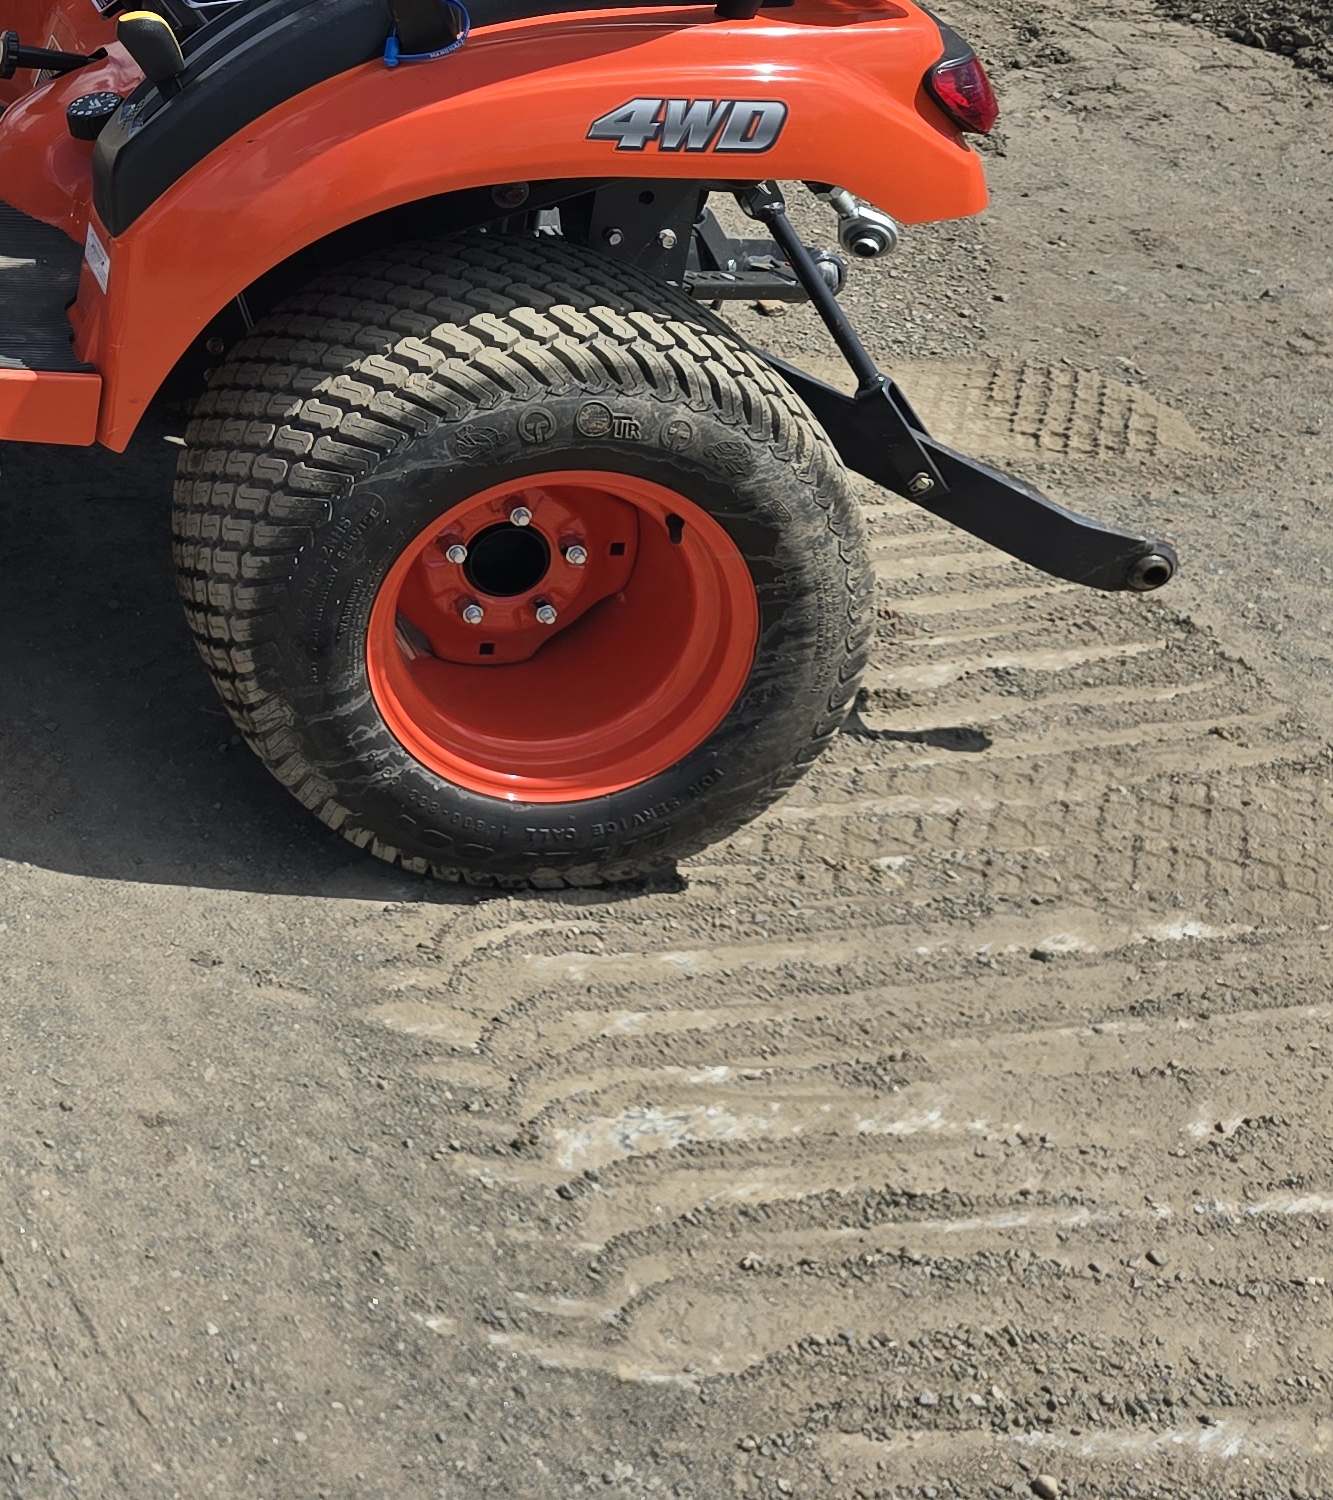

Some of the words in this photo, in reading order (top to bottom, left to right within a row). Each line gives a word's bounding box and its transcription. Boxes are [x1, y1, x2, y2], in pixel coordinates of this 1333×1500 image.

[585, 97, 788, 153] 4WD
[524, 825, 578, 841] CALL
[591, 795, 682, 839] SERVICE
